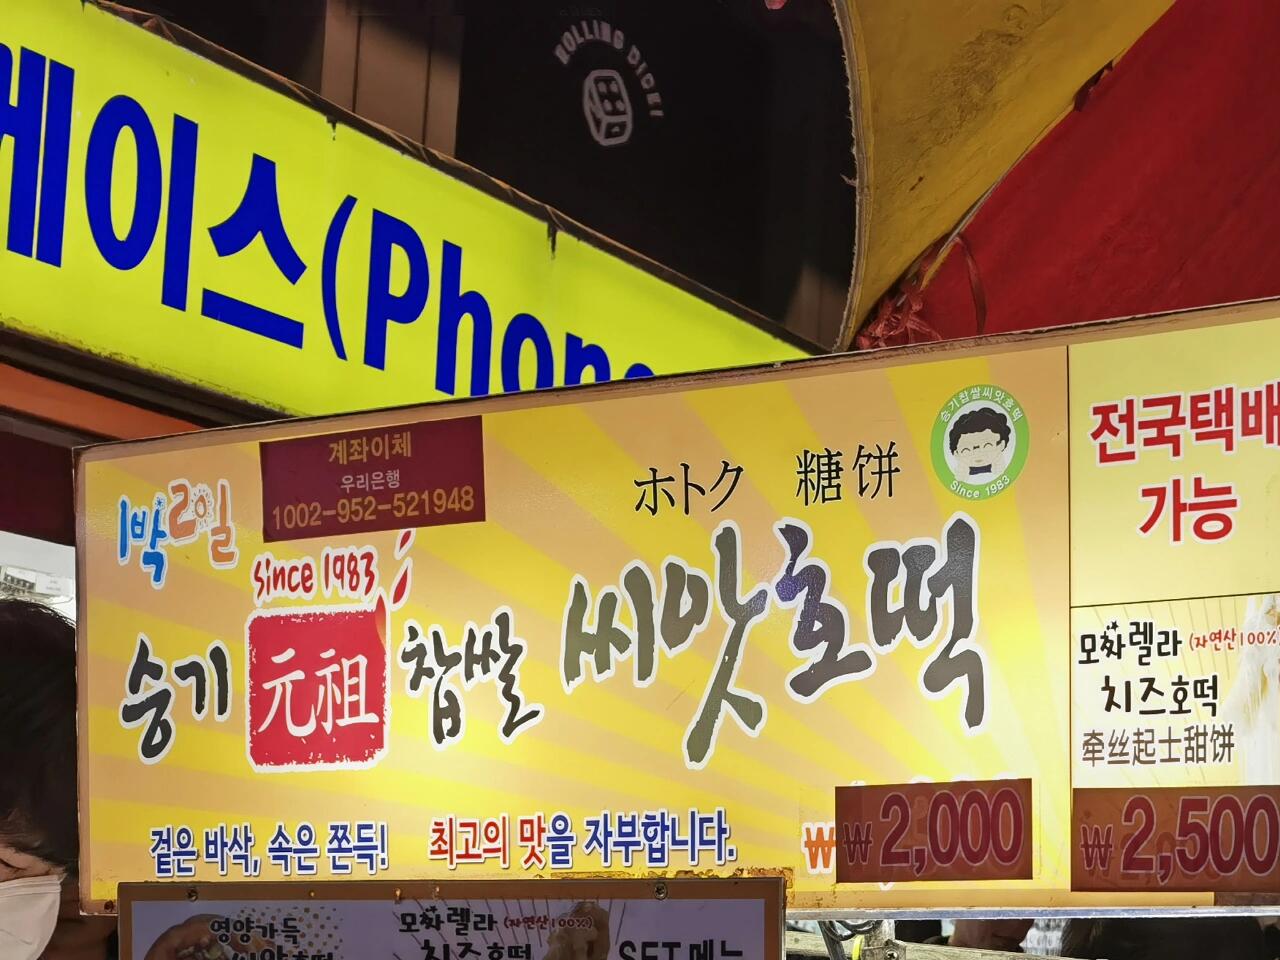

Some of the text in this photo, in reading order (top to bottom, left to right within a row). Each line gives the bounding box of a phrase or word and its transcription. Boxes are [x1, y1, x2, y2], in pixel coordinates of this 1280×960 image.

[328, 430, 412, 466] 계좌이체
[340, 466, 401, 495] 우리은행
[633, 459, 745, 516] ホトク
[796, 440, 902, 507] 糖饼
[950, 474, 1010, 498] Since 1983
[271, 486, 475, 531] 1002-952-521948
[1139, 476, 1238, 543] 가능
[323, 550, 375, 597] 1983
[121, 517, 986, 764] 승기 元祖 찹쌀 씨앗호떡
[1099, 673, 1220, 718] 치즈호떡
[1081, 722, 1235, 768] 牵丝起士甜饼
[150, 820, 389, 876] 겉은 바삭, 속은 쫀득!
[430, 808, 738, 869] 최고의 맛을 자부합니다.
[209, 916, 301, 946] 영양가득
[502, 913, 594, 932] (자연산100%)
